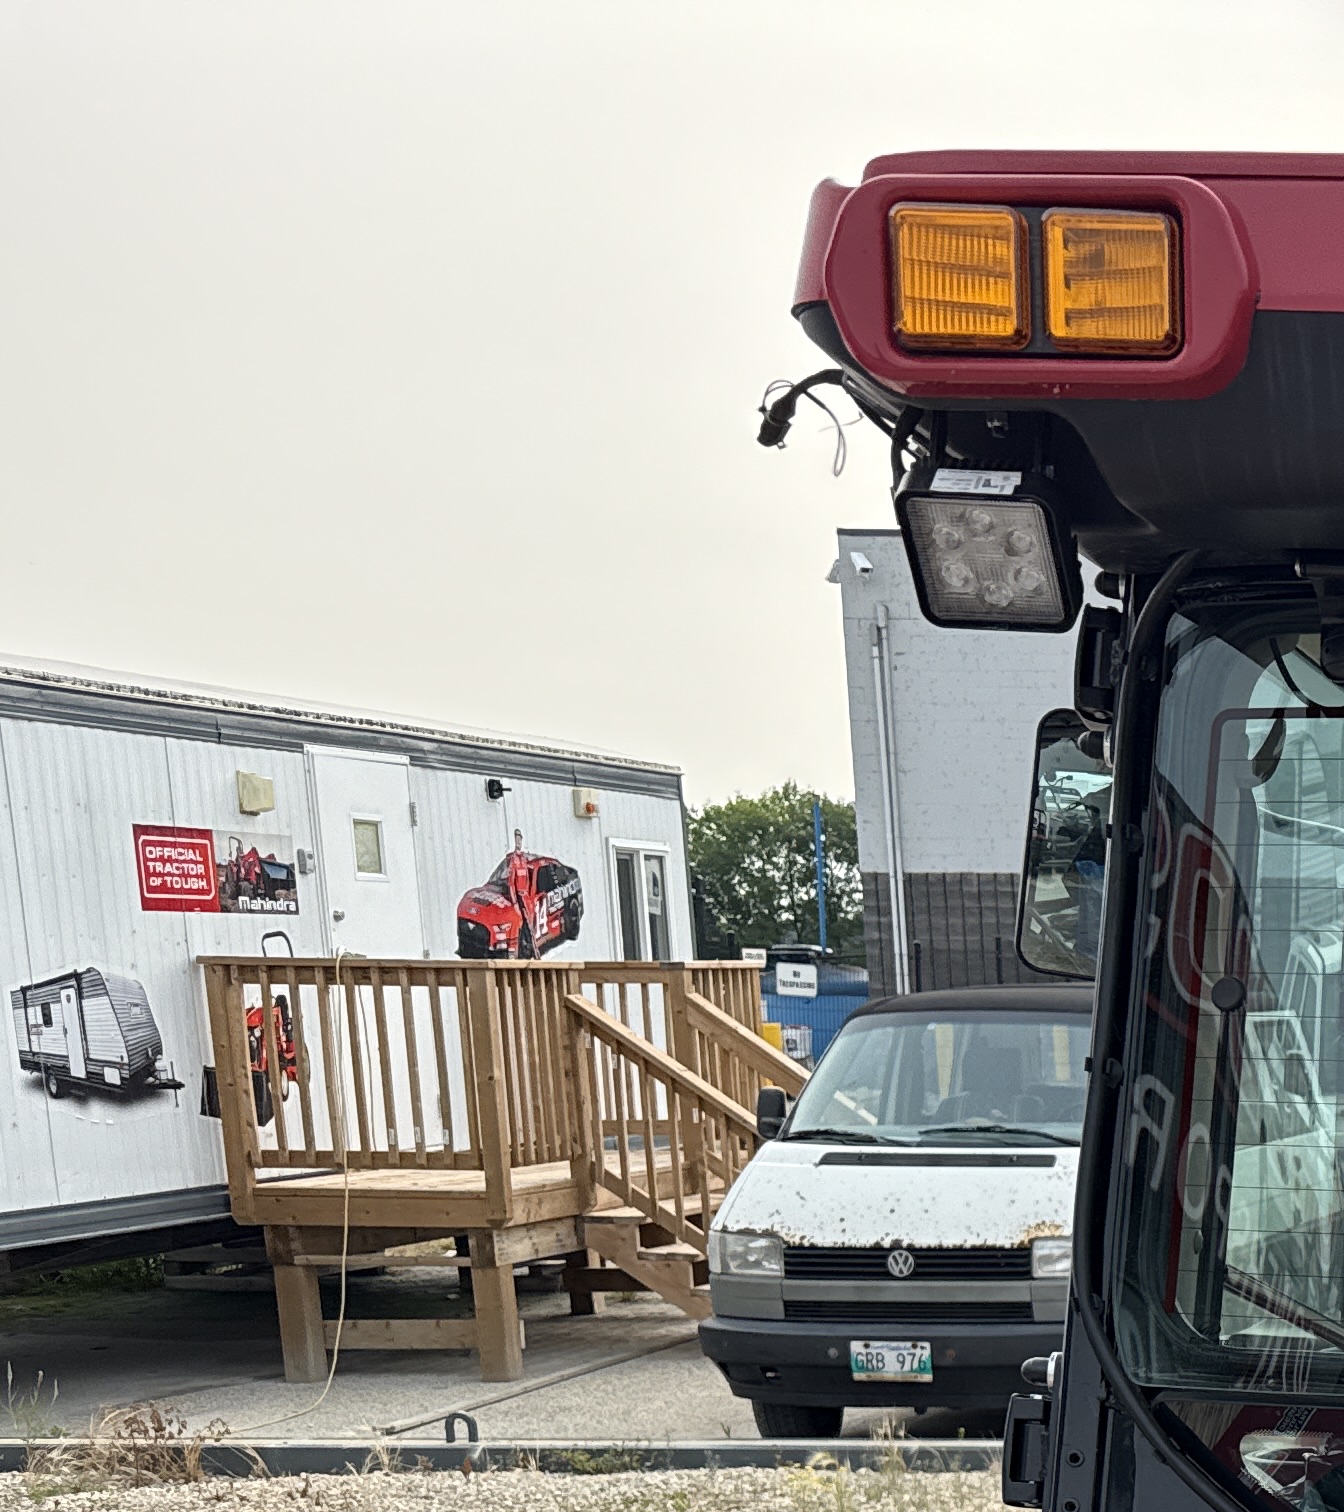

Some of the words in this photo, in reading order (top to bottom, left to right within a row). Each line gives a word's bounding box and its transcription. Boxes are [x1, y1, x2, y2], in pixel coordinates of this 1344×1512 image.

[145, 846, 204, 862] OFFICIAL
[147, 862, 206, 876] TRACTOR
[150, 876, 163, 887] OF
[855, 1352, 885, 1371] GRB
[896, 1353, 927, 1371] 976
